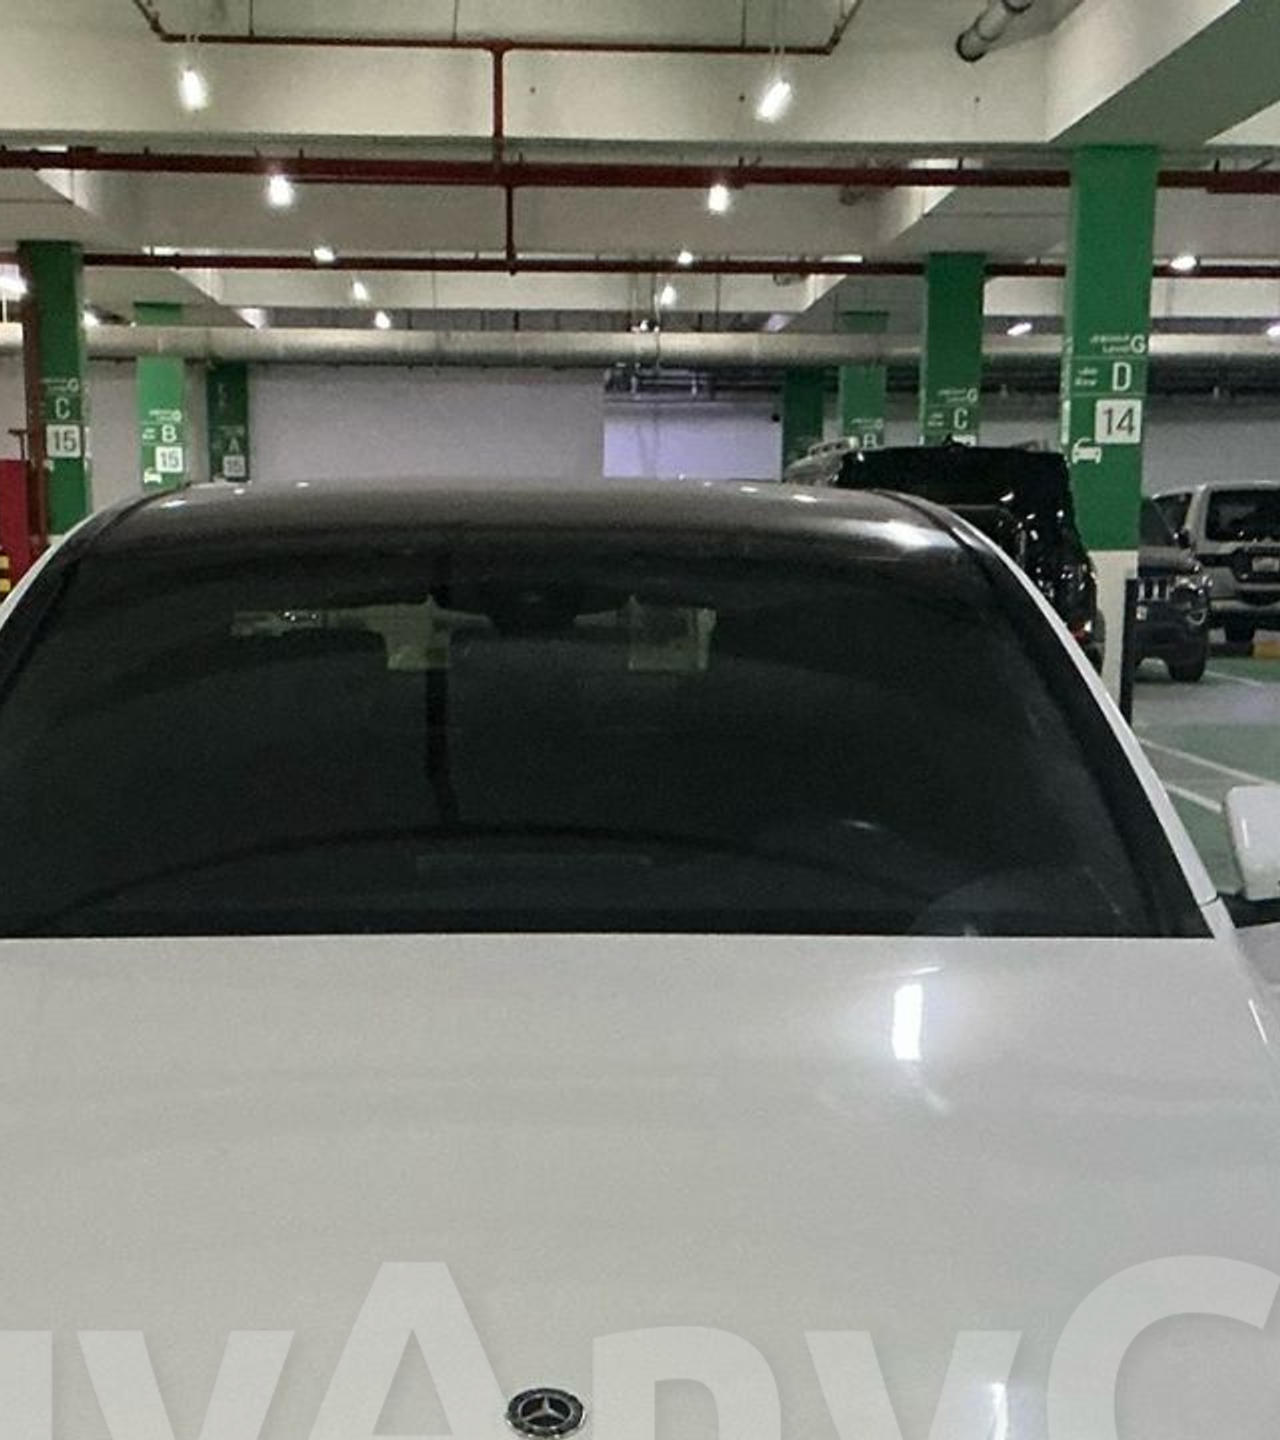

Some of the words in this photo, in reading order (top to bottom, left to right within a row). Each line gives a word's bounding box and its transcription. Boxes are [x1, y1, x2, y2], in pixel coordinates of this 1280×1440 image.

[1131, 334, 1146, 354] G
[1112, 362, 1132, 391] D
[55, 397, 71, 420] C
[953, 407, 968, 430] C
[1101, 407, 1135, 435] 14
[53, 430, 78, 452] 15
[160, 449, 180, 469] 15
